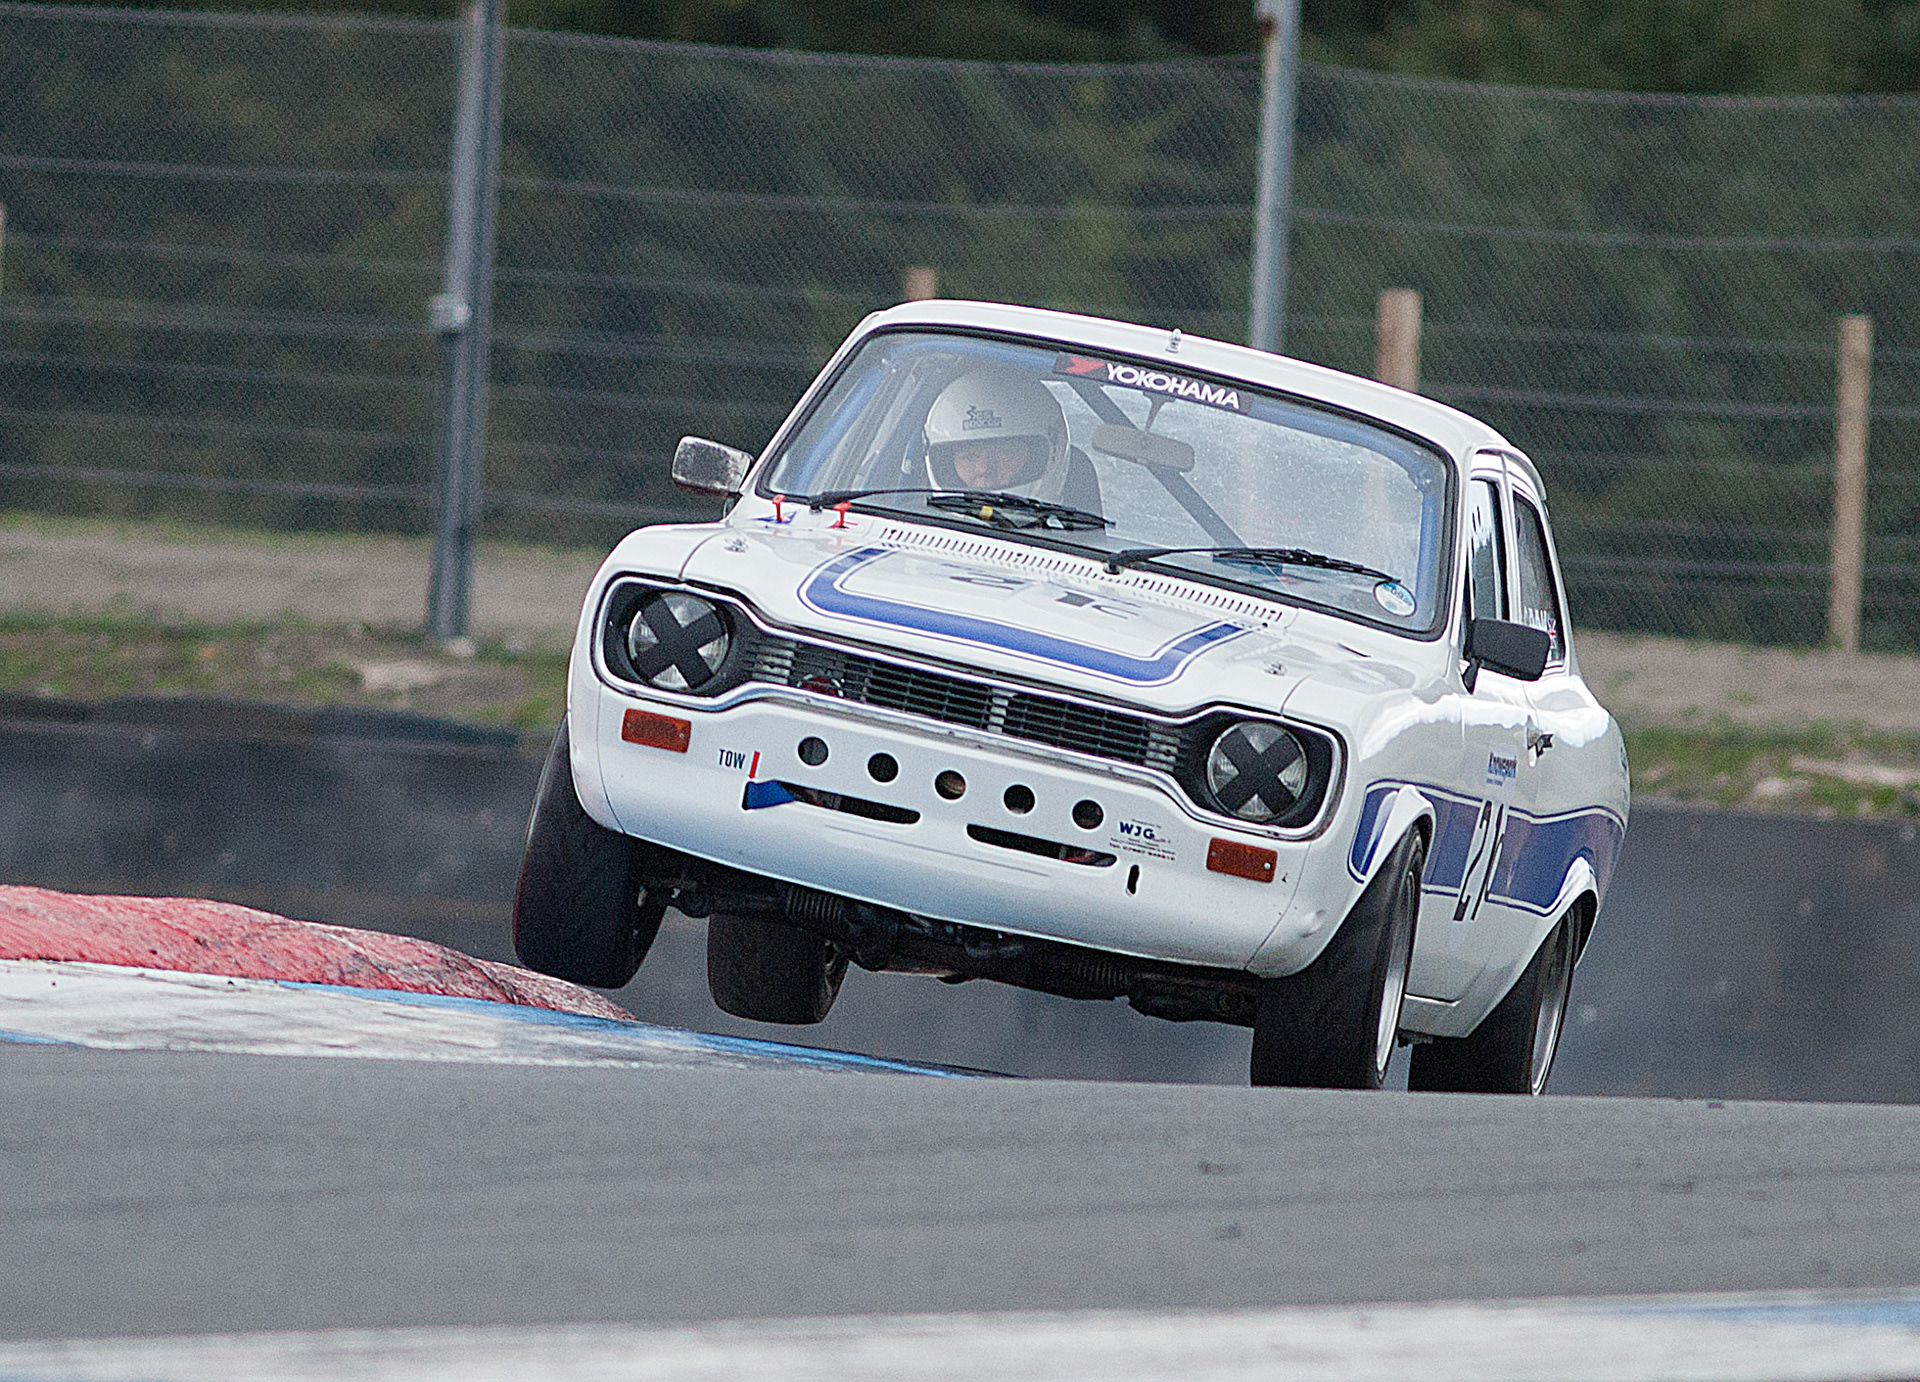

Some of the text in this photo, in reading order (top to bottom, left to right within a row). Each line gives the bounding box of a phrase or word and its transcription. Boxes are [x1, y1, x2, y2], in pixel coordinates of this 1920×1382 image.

[1106, 362, 1240, 409] YOKOHAMA
[719, 748, 746, 770] TOW
[1119, 821, 1155, 840] WJG
